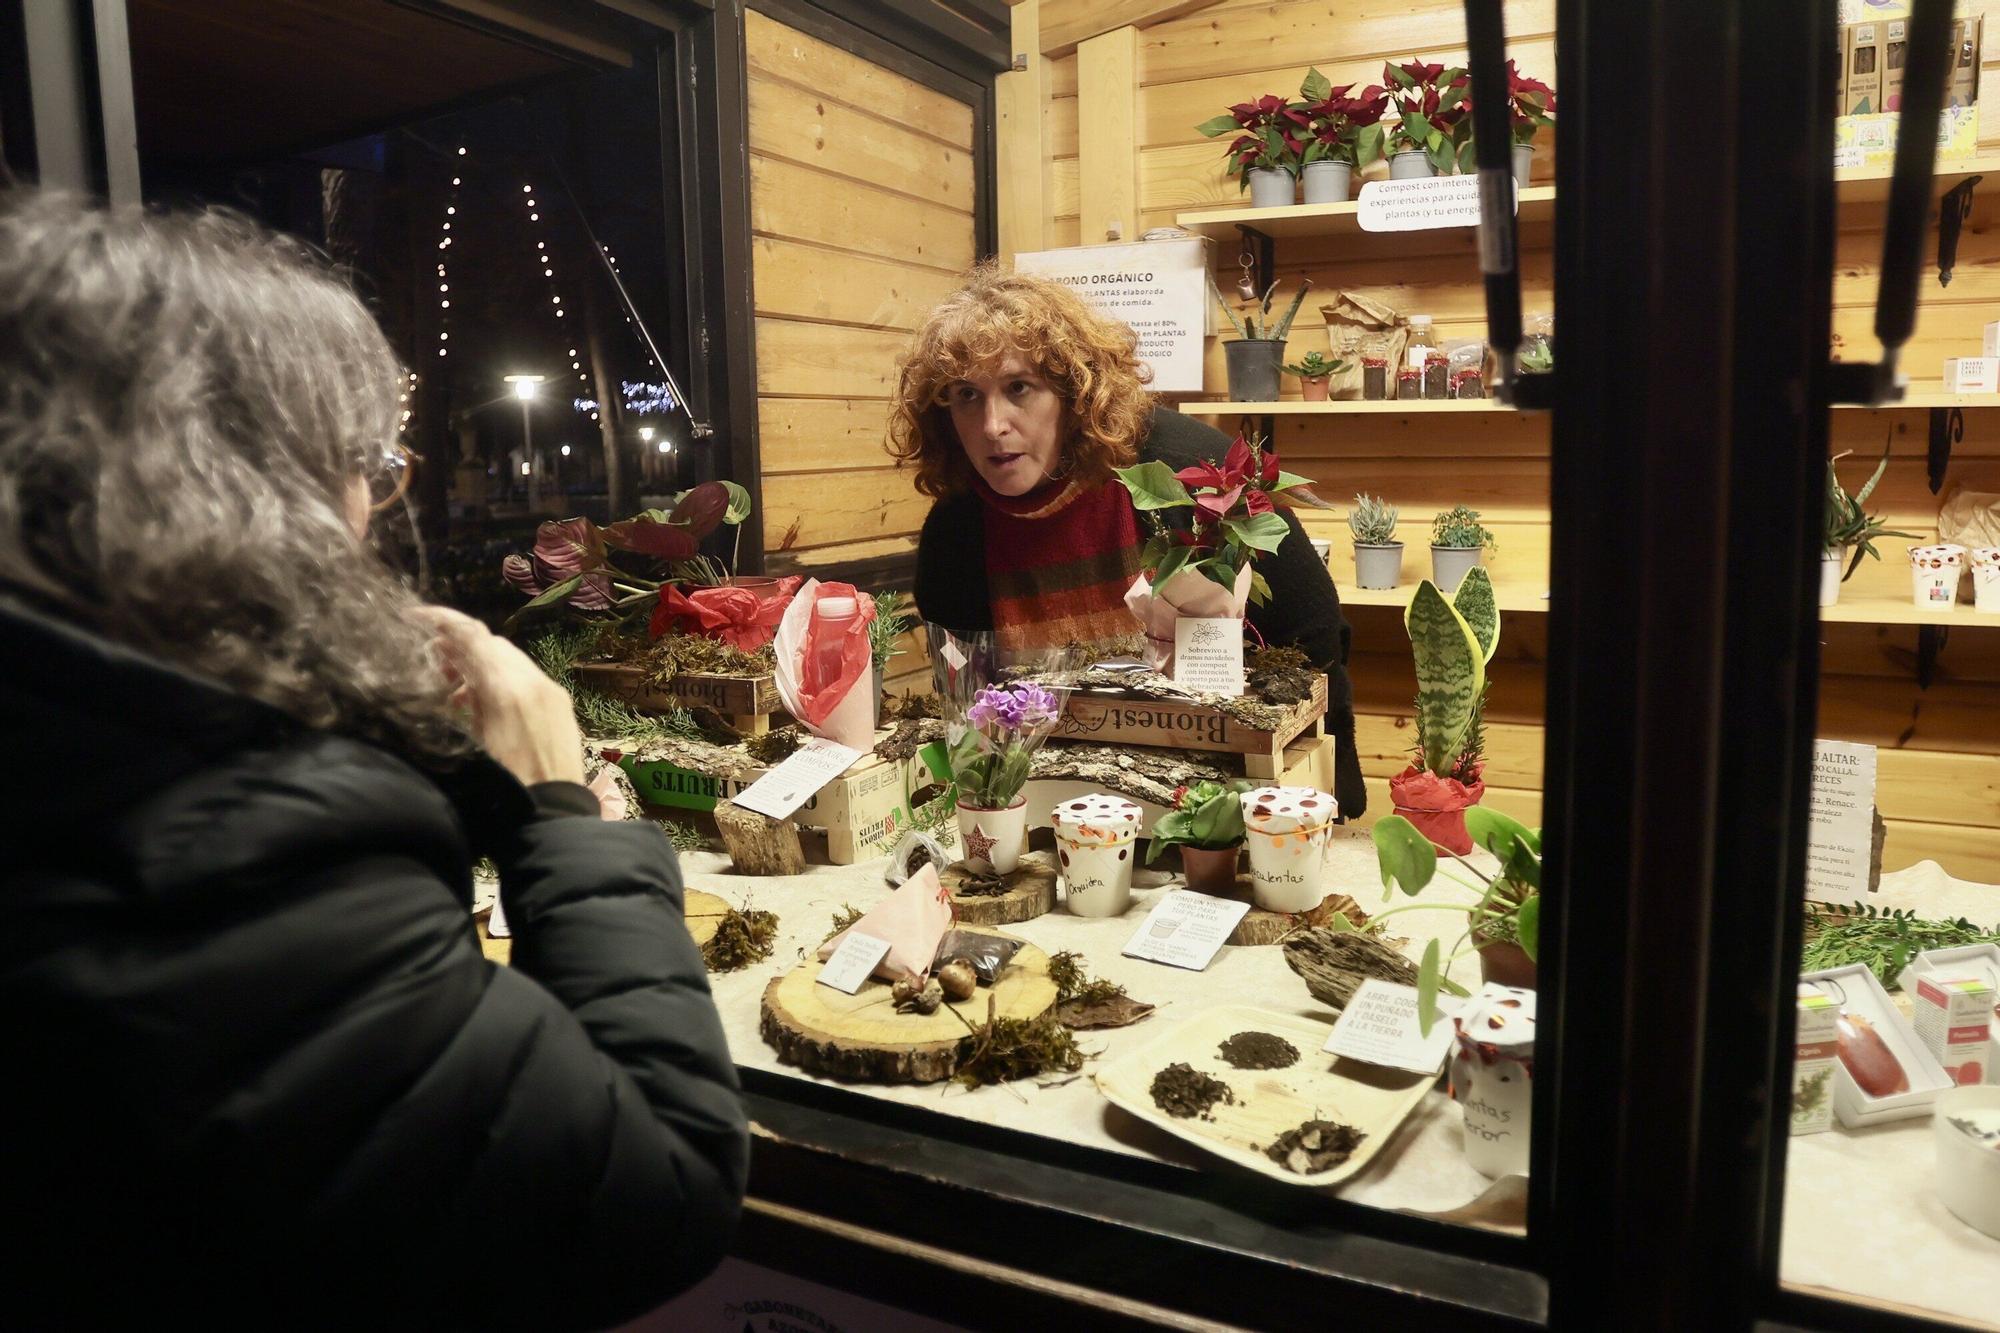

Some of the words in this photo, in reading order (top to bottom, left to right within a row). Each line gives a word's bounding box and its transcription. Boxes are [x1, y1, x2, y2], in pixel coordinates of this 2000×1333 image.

[1378, 182, 1420, 194] Compost
[1422, 181, 1440, 190] con
[1370, 196, 1430, 208] experiencias
[1432, 194, 1454, 204] para
[1385, 209, 1420, 220] plantas
[1434, 208, 1444, 216] tu
[1091, 271, 1154, 284] ORGÁNICO
[1084, 289, 1121, 298] PLANTAS
[1122, 288, 1164, 297] elaborada
[1110, 300, 1120, 308] de
[1180, 653, 1203, 661] dramas
[1110, 708, 1231, 745] Bionest
[651, 769, 729, 799] FRUITS
[859, 819, 884, 837] FRUITS
[860, 829, 885, 847] GIRONA
[1359, 1000, 1374, 1010] UN
[1354, 1009, 1361, 1018] Y
[1347, 1019, 1355, 1028] A
[1355, 1021, 1368, 1030] LA
[1370, 1024, 1404, 1038] TIERRA
